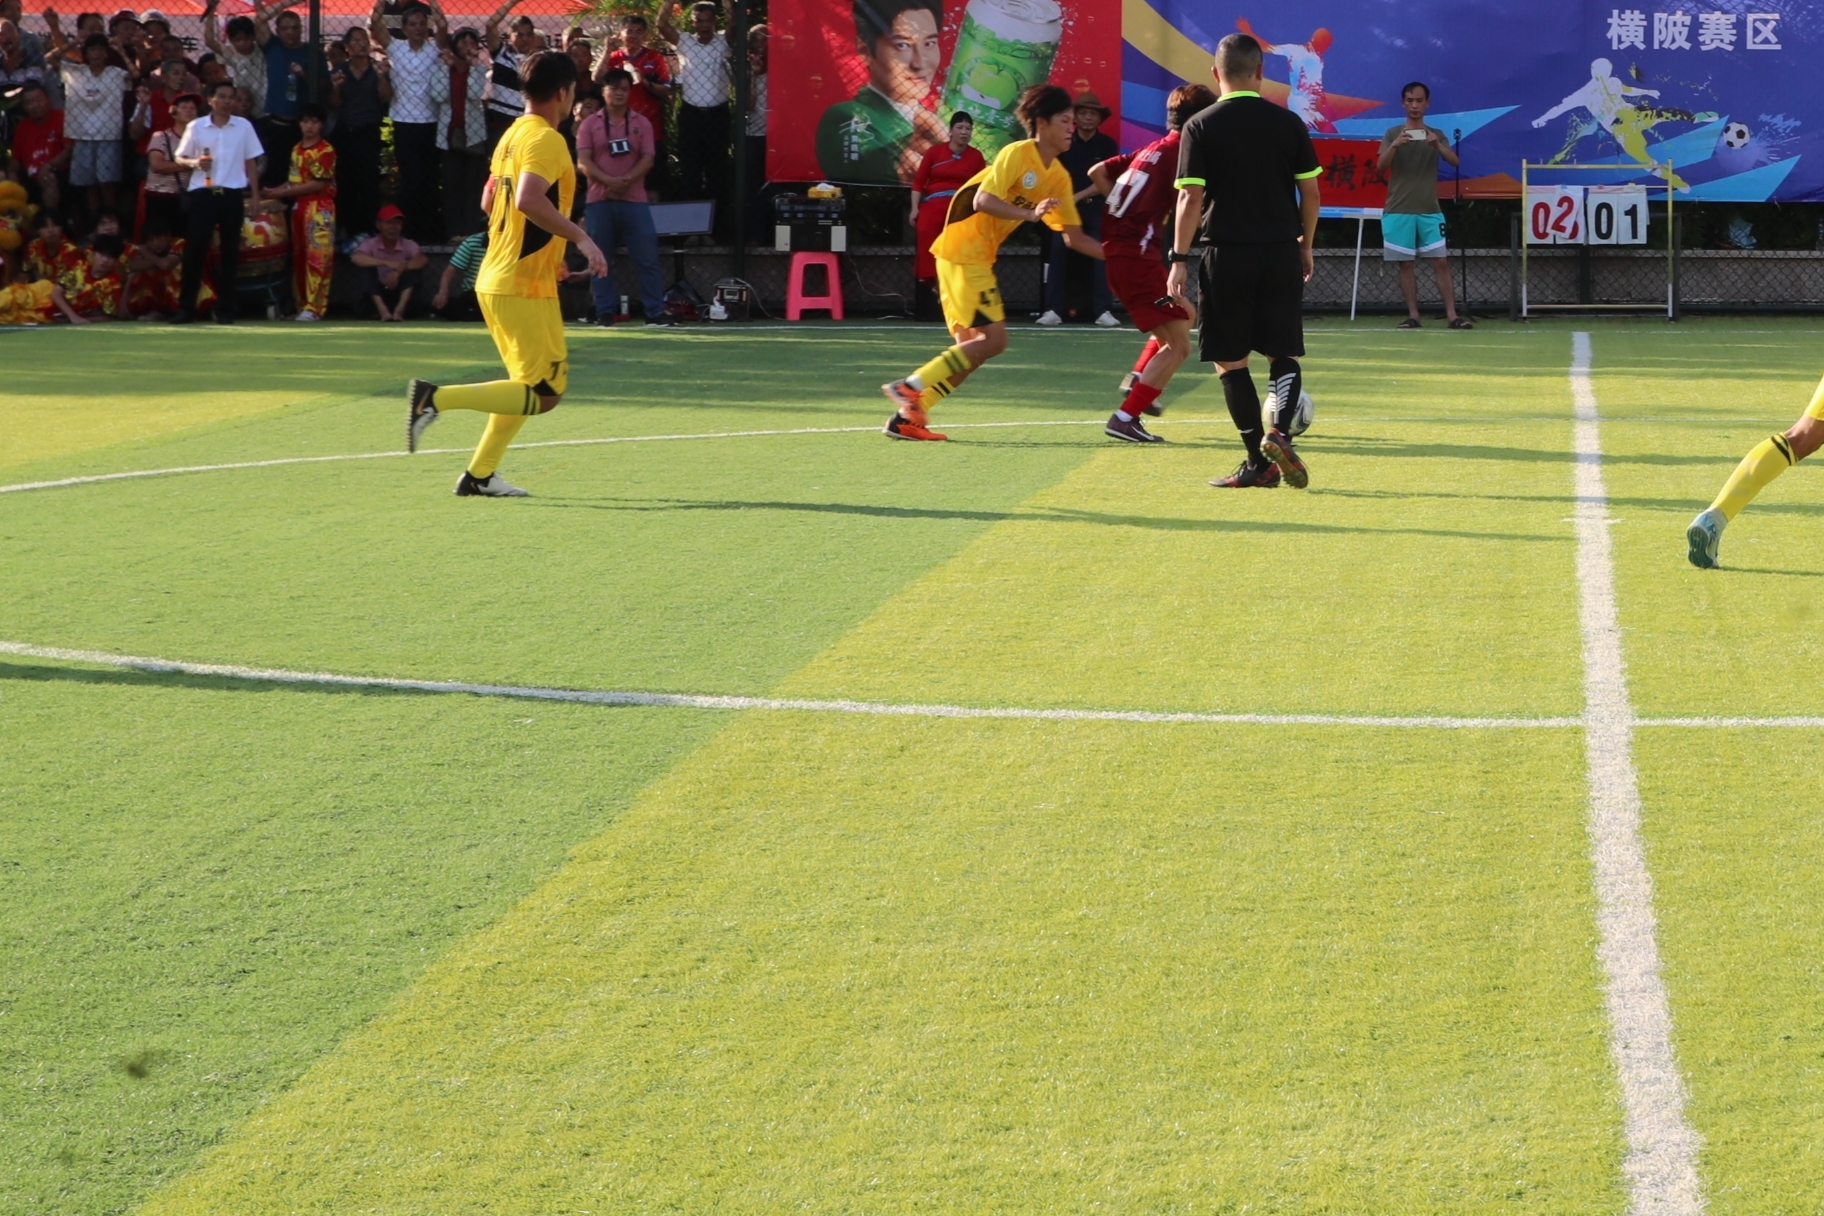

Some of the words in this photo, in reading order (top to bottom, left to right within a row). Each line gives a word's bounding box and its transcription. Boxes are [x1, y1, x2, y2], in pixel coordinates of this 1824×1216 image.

[1607, 9, 1782, 51] 横陂赛区
[1595, 202, 1641, 240] 01
